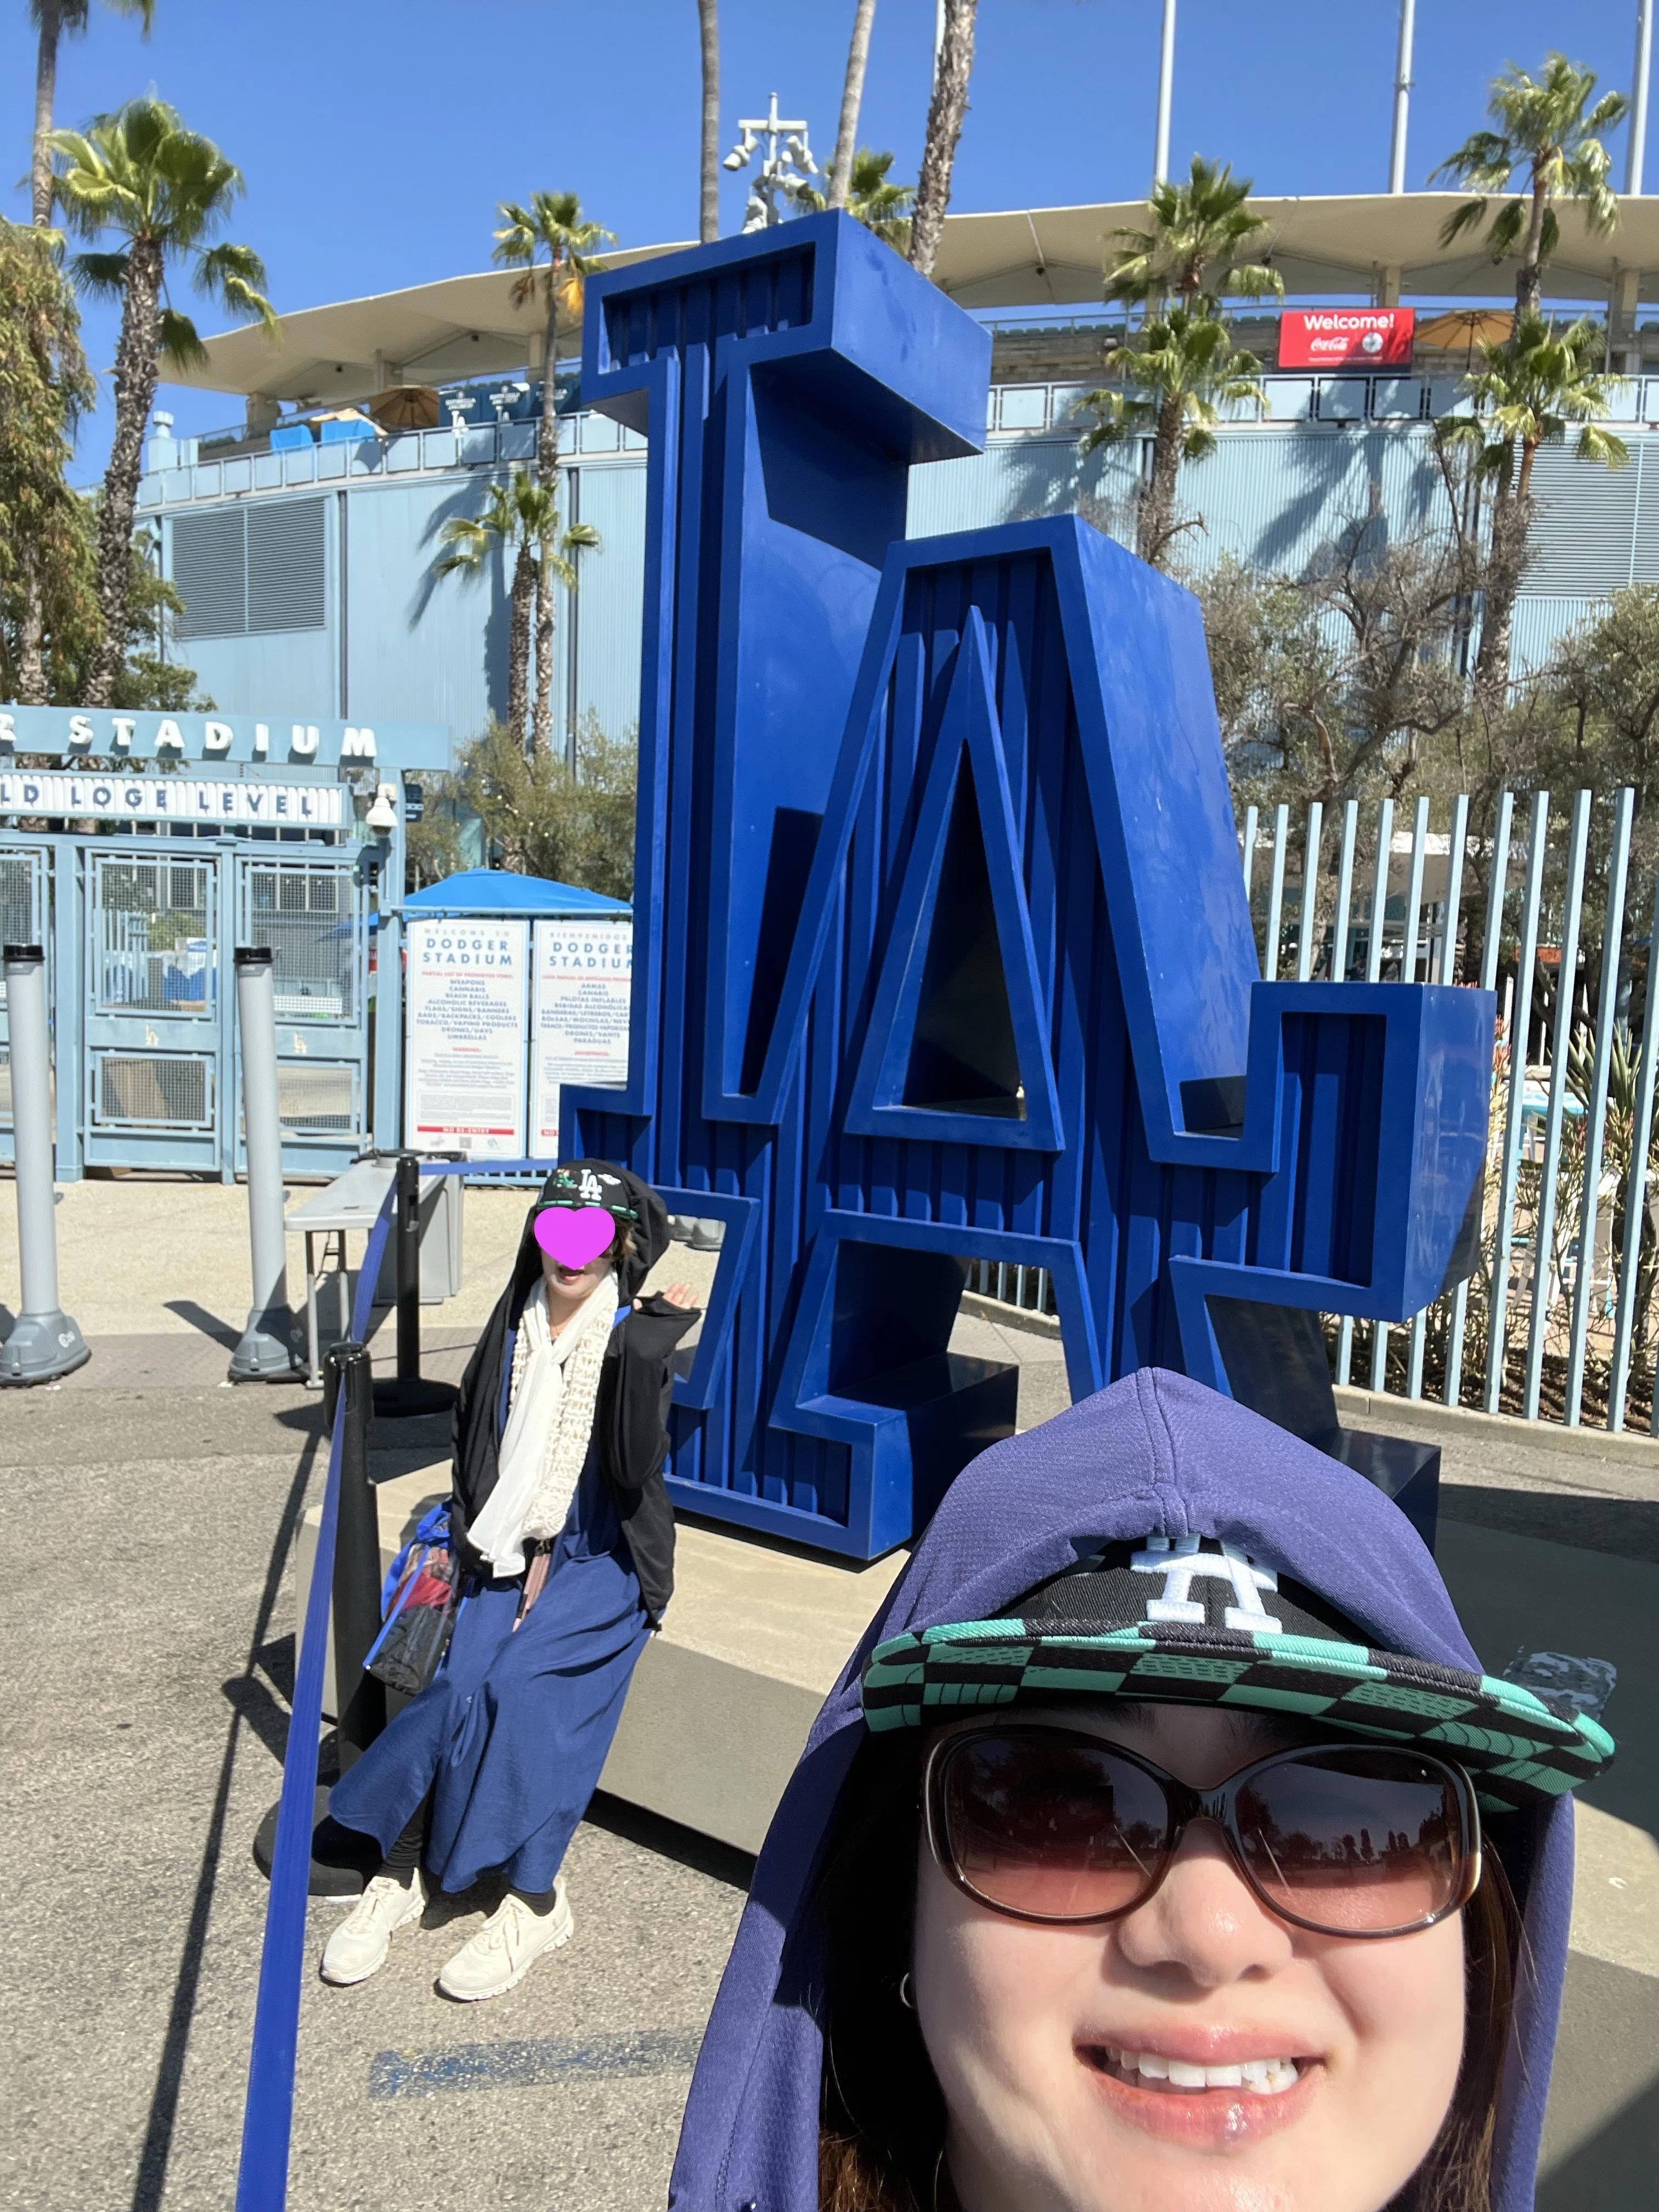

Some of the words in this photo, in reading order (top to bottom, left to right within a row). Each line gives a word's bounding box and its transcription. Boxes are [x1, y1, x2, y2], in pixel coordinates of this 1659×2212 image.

[1304, 313, 1395, 330] Welcome!
[68, 715, 377, 757] STADIUM
[71, 786, 167, 807] LOGE
[199, 791, 313, 816] LEVEL
[426, 938, 509, 951] DODGER
[553, 942, 633, 954] DODGER
[423, 952, 512, 966] STADIUM
[579, 1169, 602, 1200] LA
